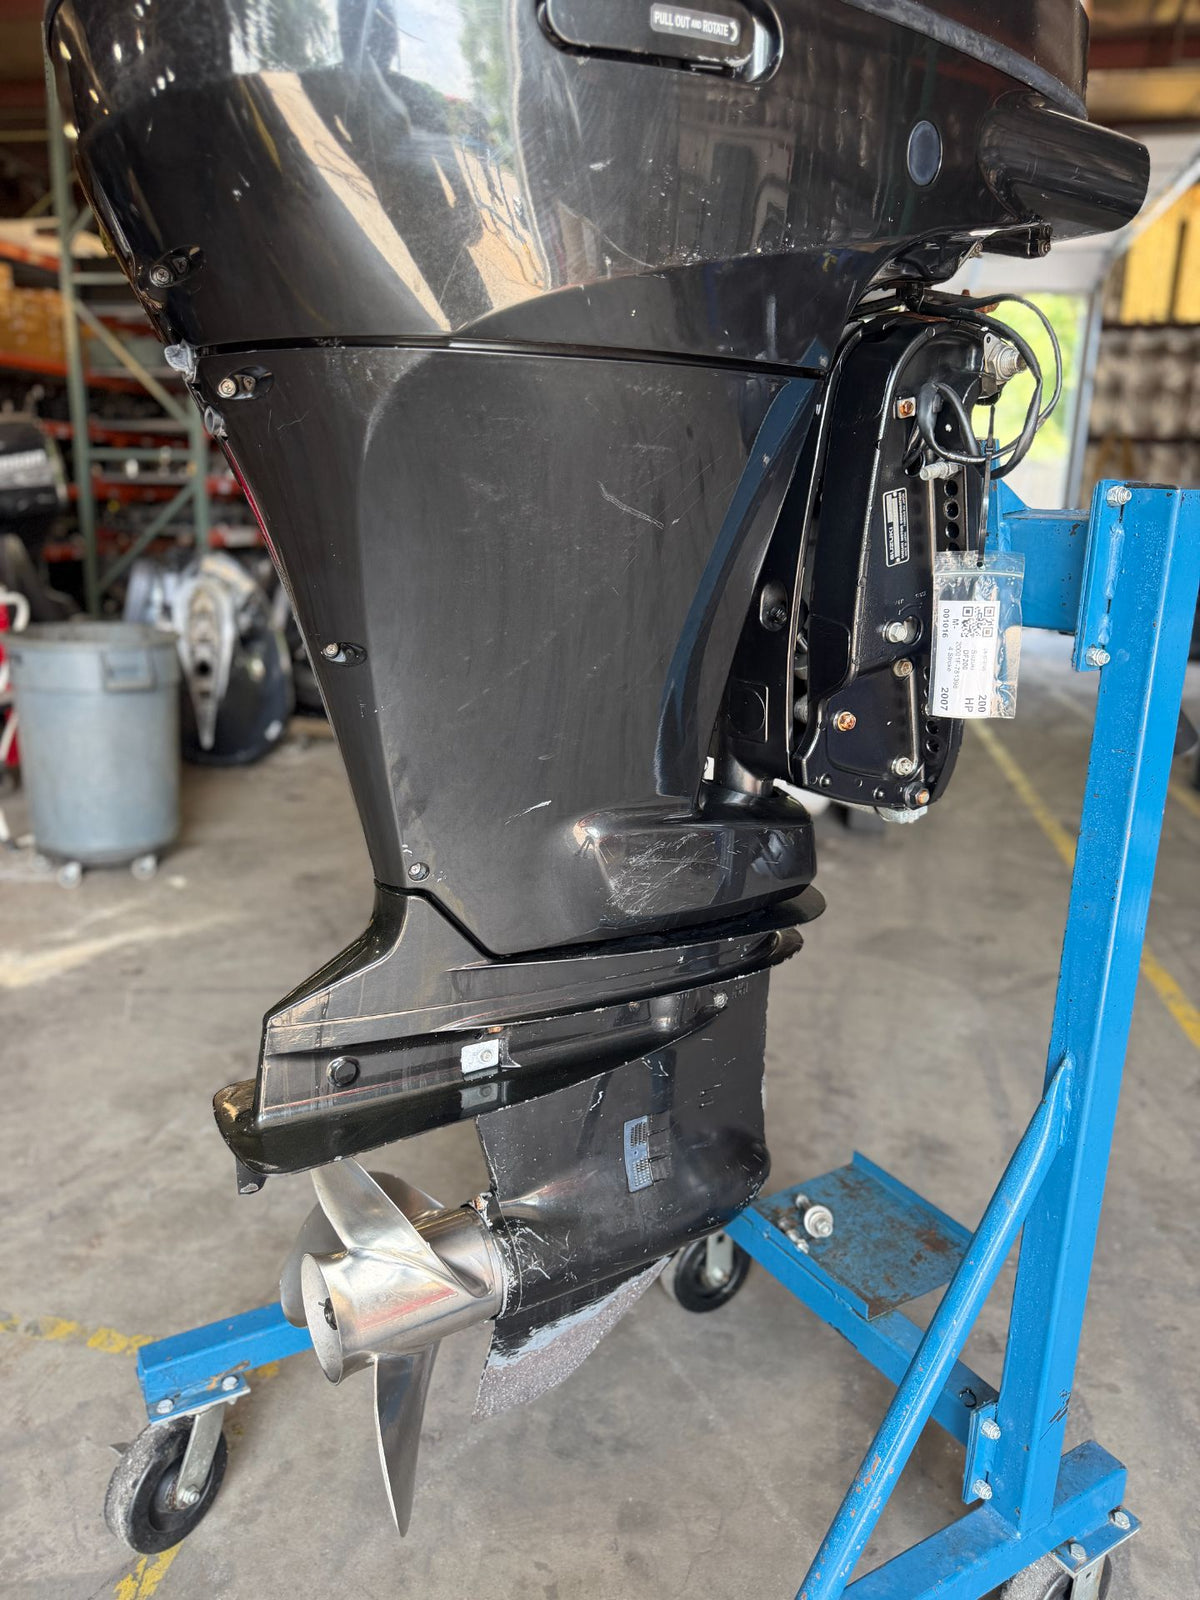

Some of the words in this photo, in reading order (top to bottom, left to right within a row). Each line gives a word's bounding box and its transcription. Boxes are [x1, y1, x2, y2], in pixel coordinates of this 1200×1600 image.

[654, 11, 674, 26] PULL
[675, 15, 690, 29] OUT
[691, 19, 701, 30] AND
[702, 20, 729, 37] ROTATE
[942, 608, 951, 639] 001016
[962, 649, 970, 670] DF200
[940, 687, 949, 712] 2007
[964, 697, 975, 713] HP
[977, 694, 988, 713] 200
